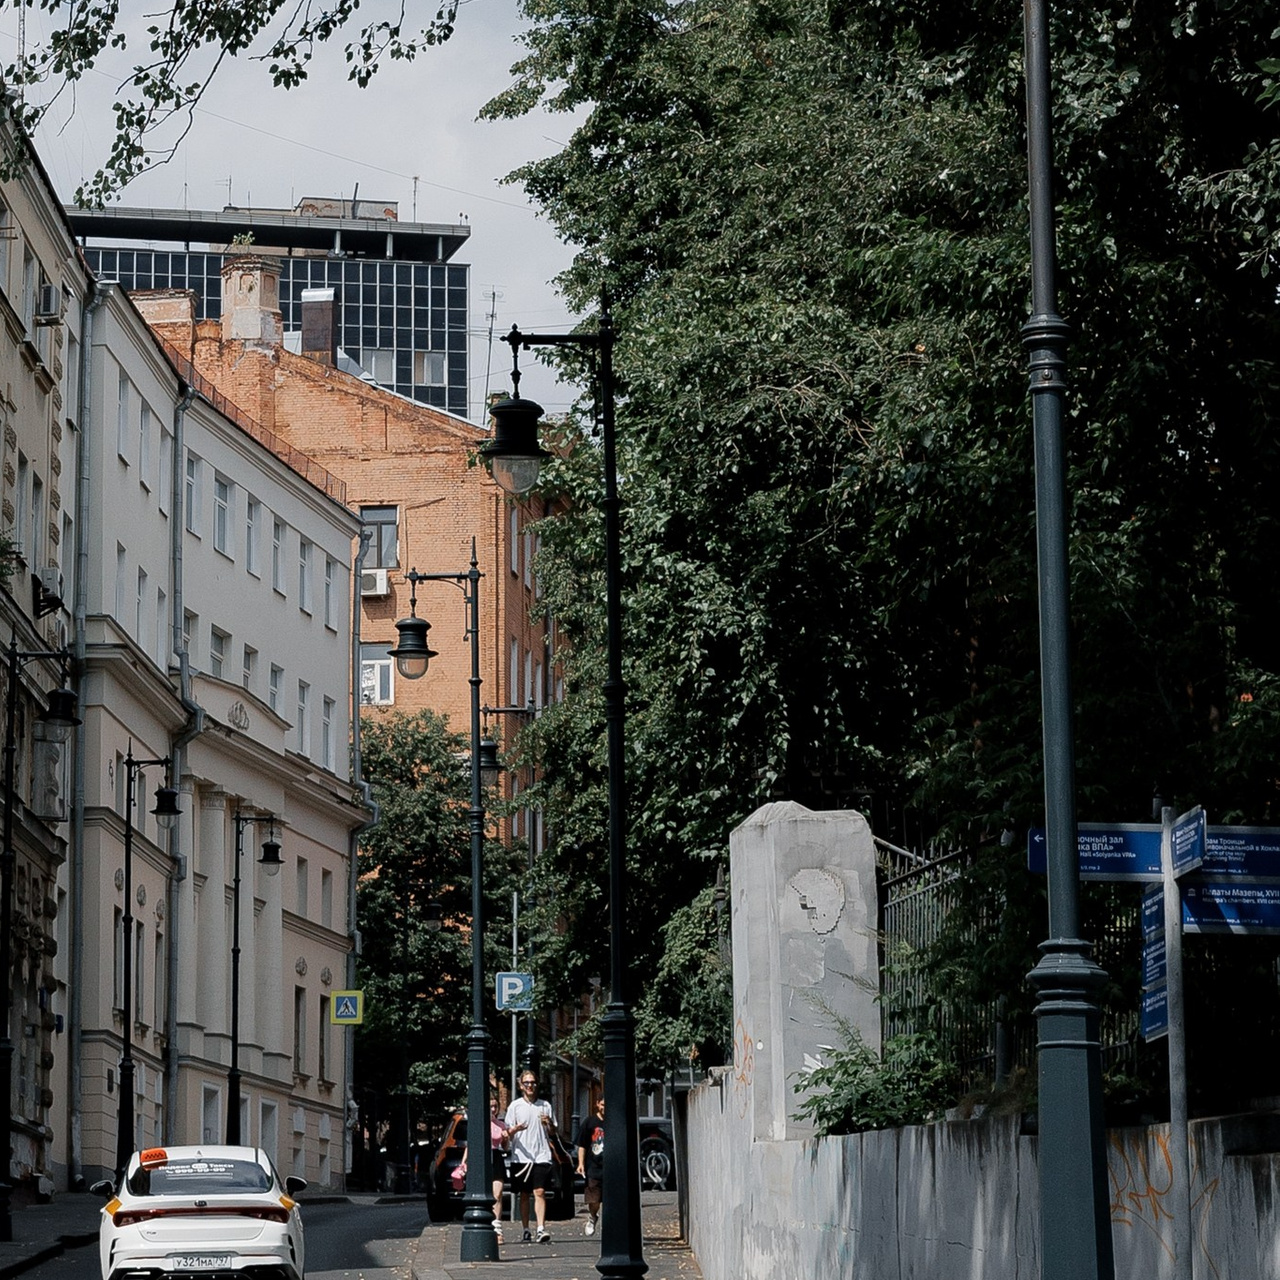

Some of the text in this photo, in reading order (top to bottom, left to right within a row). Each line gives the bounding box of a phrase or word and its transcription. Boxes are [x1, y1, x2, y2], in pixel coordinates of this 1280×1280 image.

[1077, 835, 1107, 844] очный
[1219, 838, 1245, 846] Троицы
[1092, 843, 1114, 851] ВПА»
[1202, 888, 1231, 896] Палаты
[1232, 889, 1264, 898] Мазепы,
[502, 977, 524, 1005] P
[176, 1257, 213, 1267] У321МА
